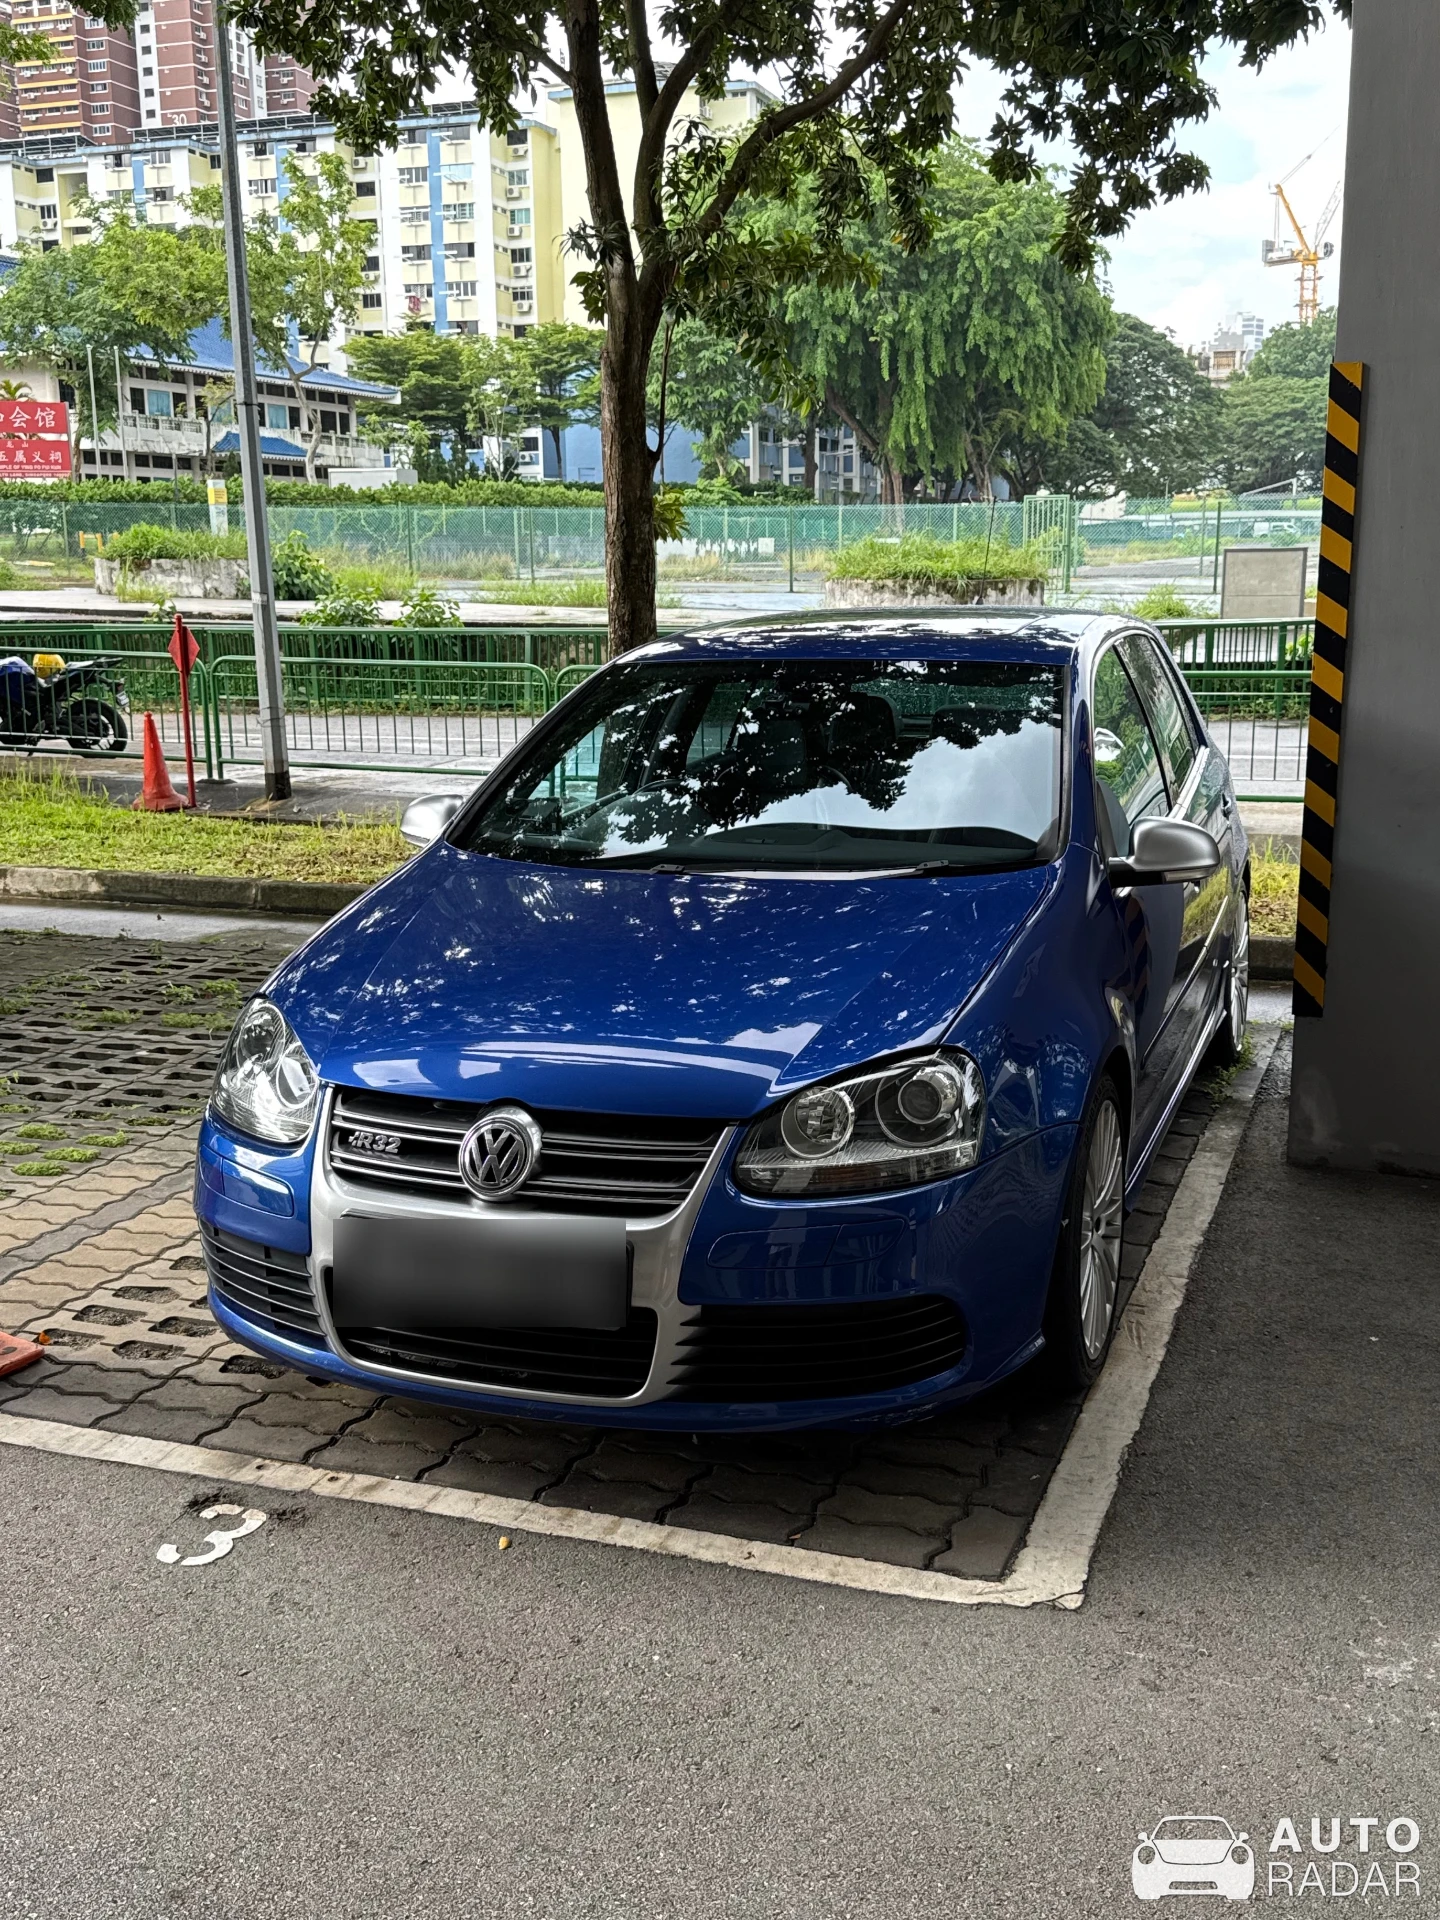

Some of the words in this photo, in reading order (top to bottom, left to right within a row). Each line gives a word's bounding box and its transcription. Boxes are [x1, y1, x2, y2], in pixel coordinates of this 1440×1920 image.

[349, 1130, 401, 1153] R32
[465, 1121, 527, 1187] VW
[156, 1503, 266, 1566] 3
